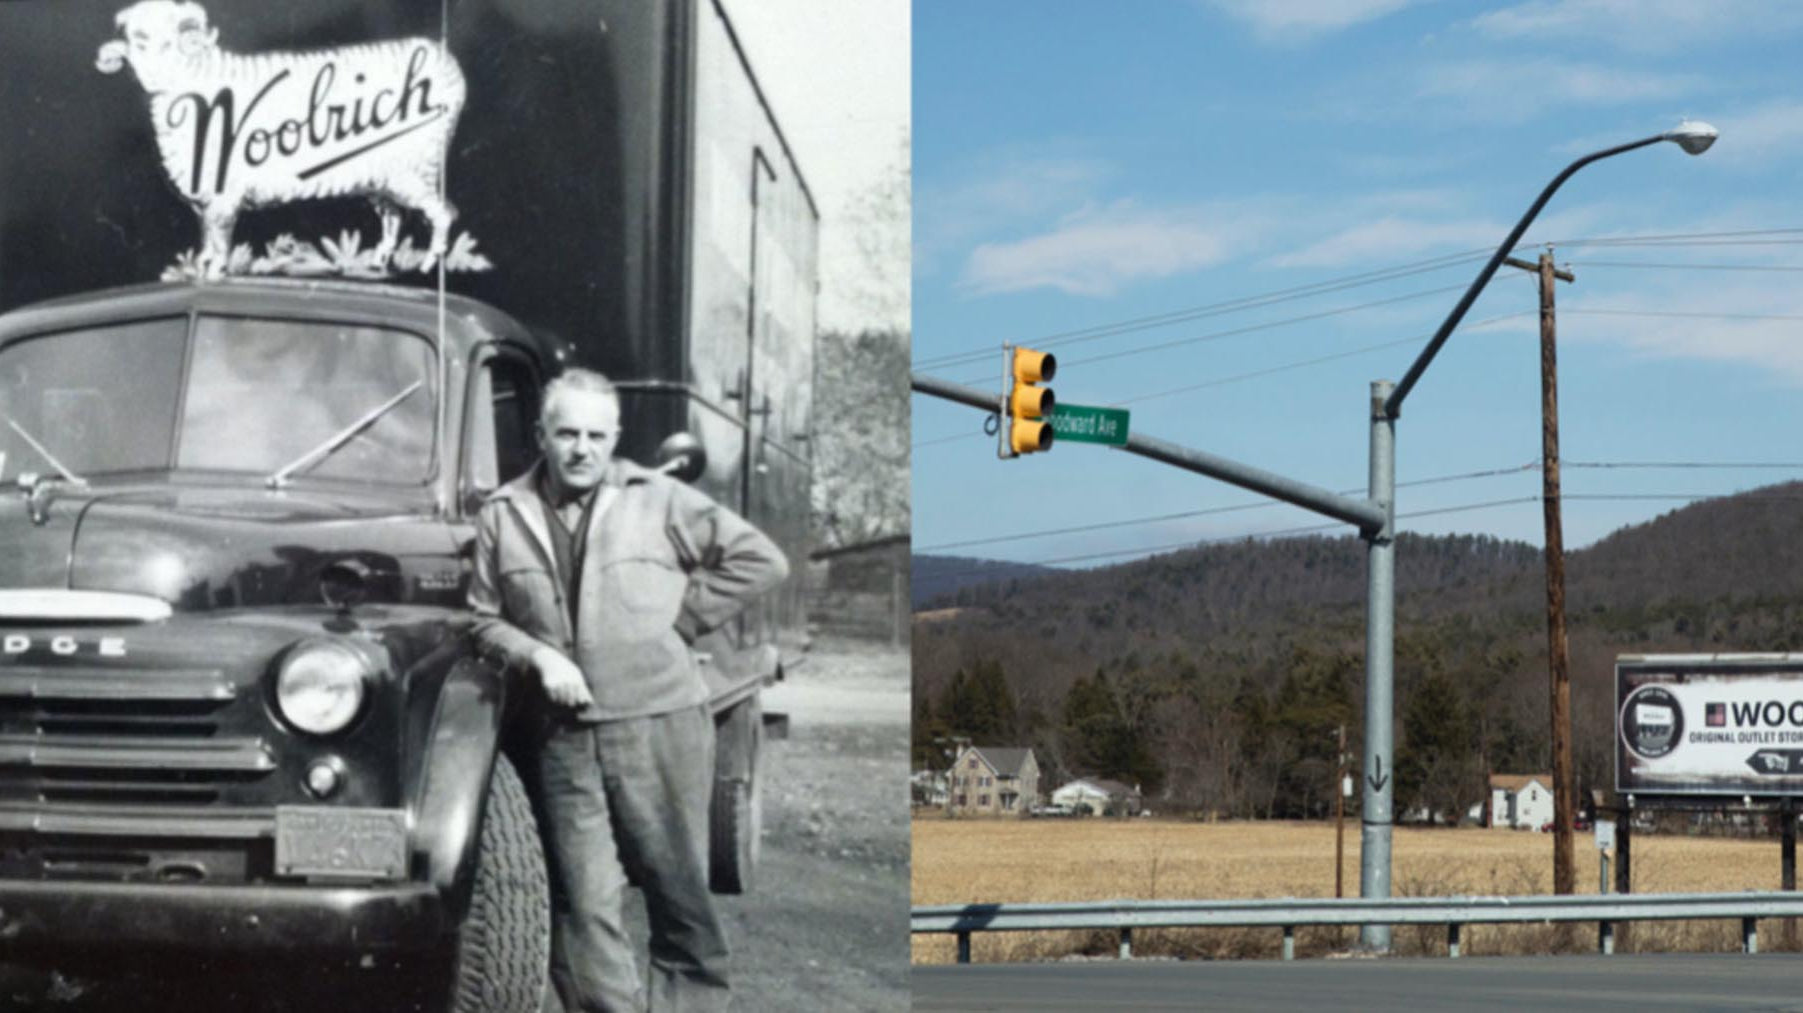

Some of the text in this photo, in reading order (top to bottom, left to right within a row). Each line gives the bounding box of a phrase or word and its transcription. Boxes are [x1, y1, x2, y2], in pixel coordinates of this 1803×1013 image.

[167, 46, 445, 194] Woolrich
[1045, 411, 1117, 437] oodward Ave
[1689, 732, 1735, 744] ORIGINAL
[1738, 732, 1775, 744] OUTLET
